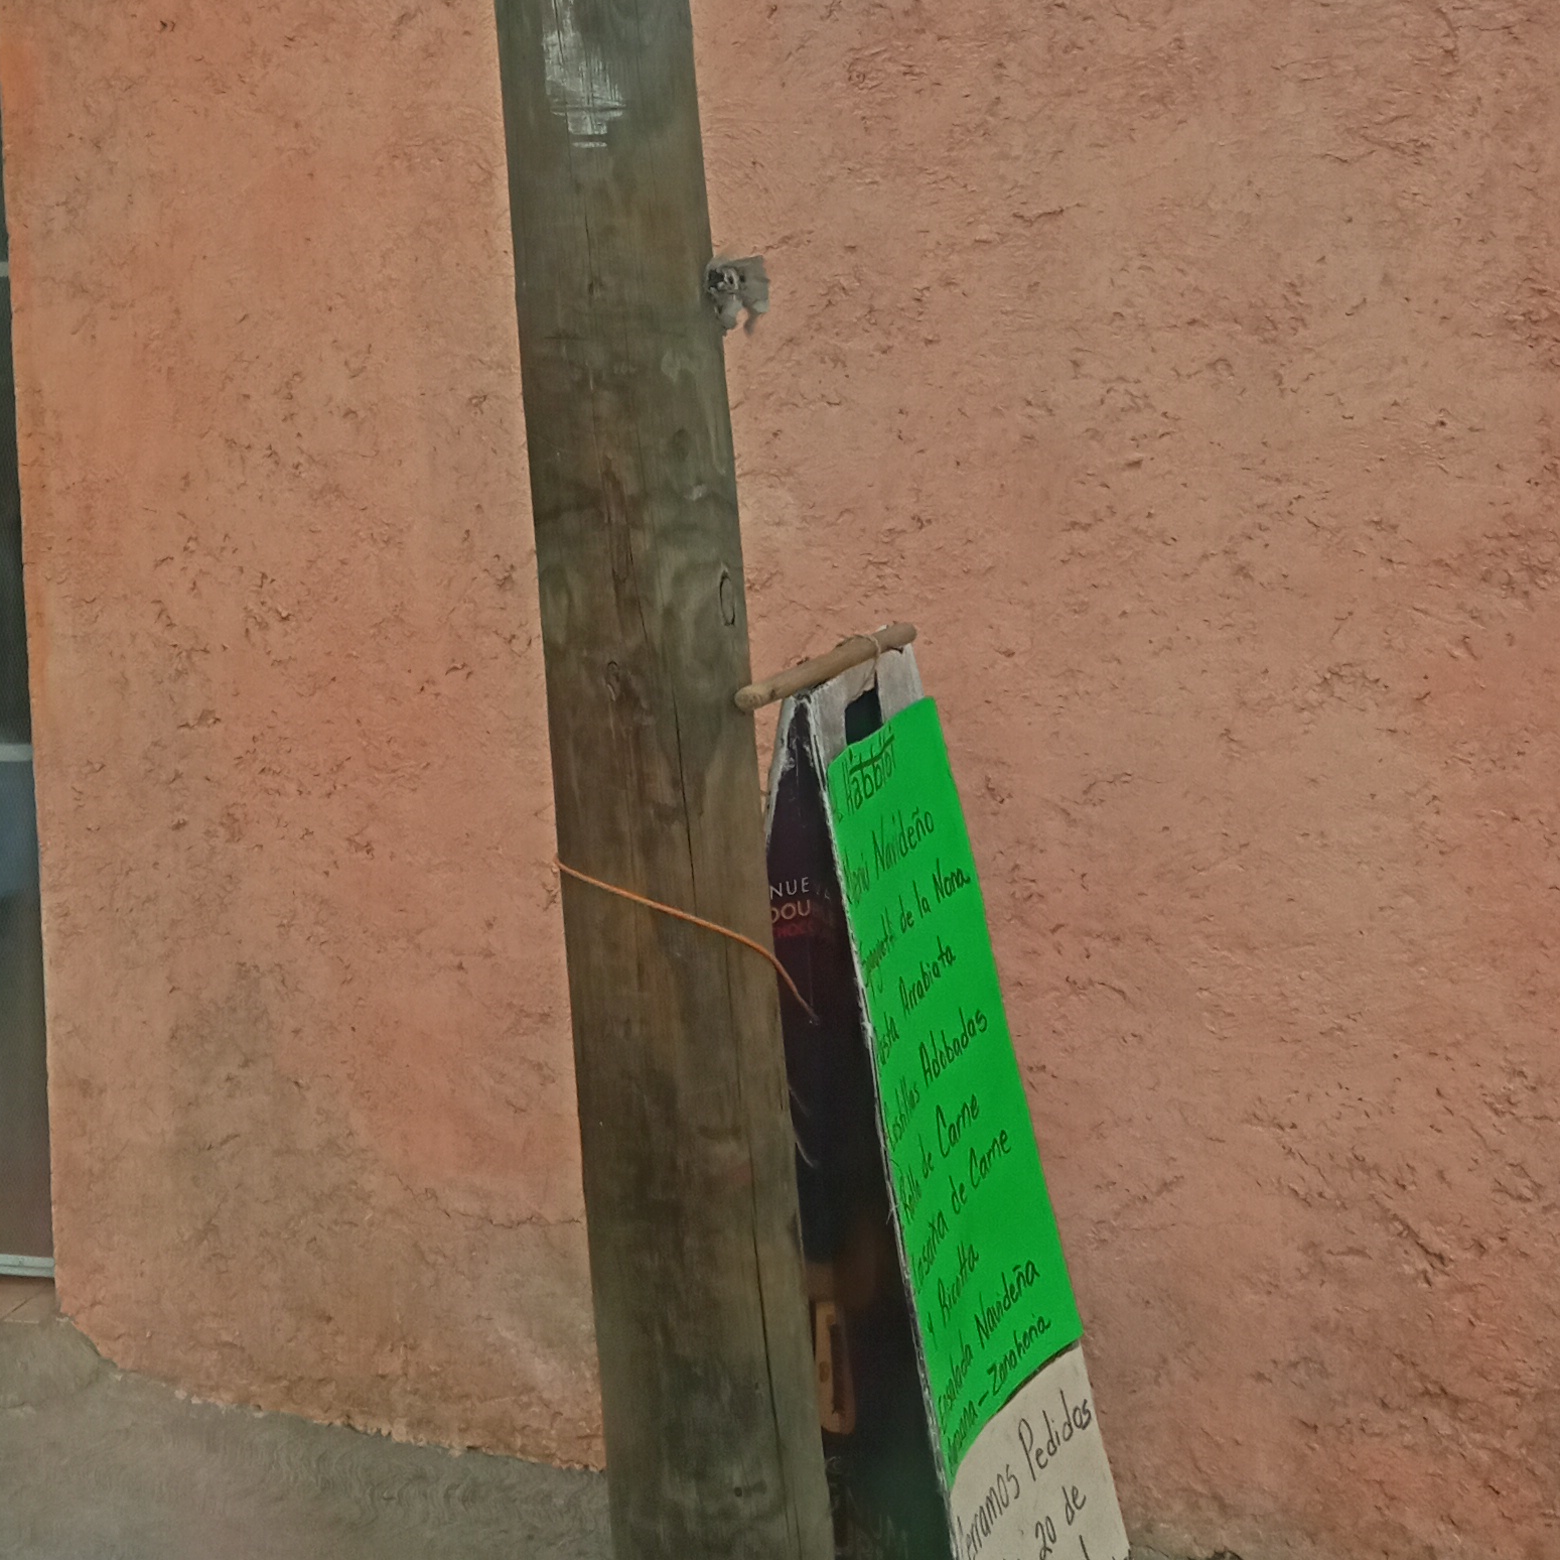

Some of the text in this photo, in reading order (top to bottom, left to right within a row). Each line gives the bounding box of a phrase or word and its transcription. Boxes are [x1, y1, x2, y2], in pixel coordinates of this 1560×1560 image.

[769, 876, 810, 900] NUE
[898, 894, 915, 934] de
[912, 879, 932, 919] la
[898, 935, 957, 1020] Arrabiata
[918, 1006, 988, 1088] Adobadas
[917, 1132, 934, 1179] de
[935, 1093, 980, 1158] Carne
[948, 1174, 968, 1215] de
[969, 1128, 1011, 1190] Carne
[937, 1240, 979, 1329] Ricotta
[973, 1259, 1041, 1350] Navideña
[1017, 1387, 1092, 1482] Pedidos
[1061, 1485, 1087, 1526] de
